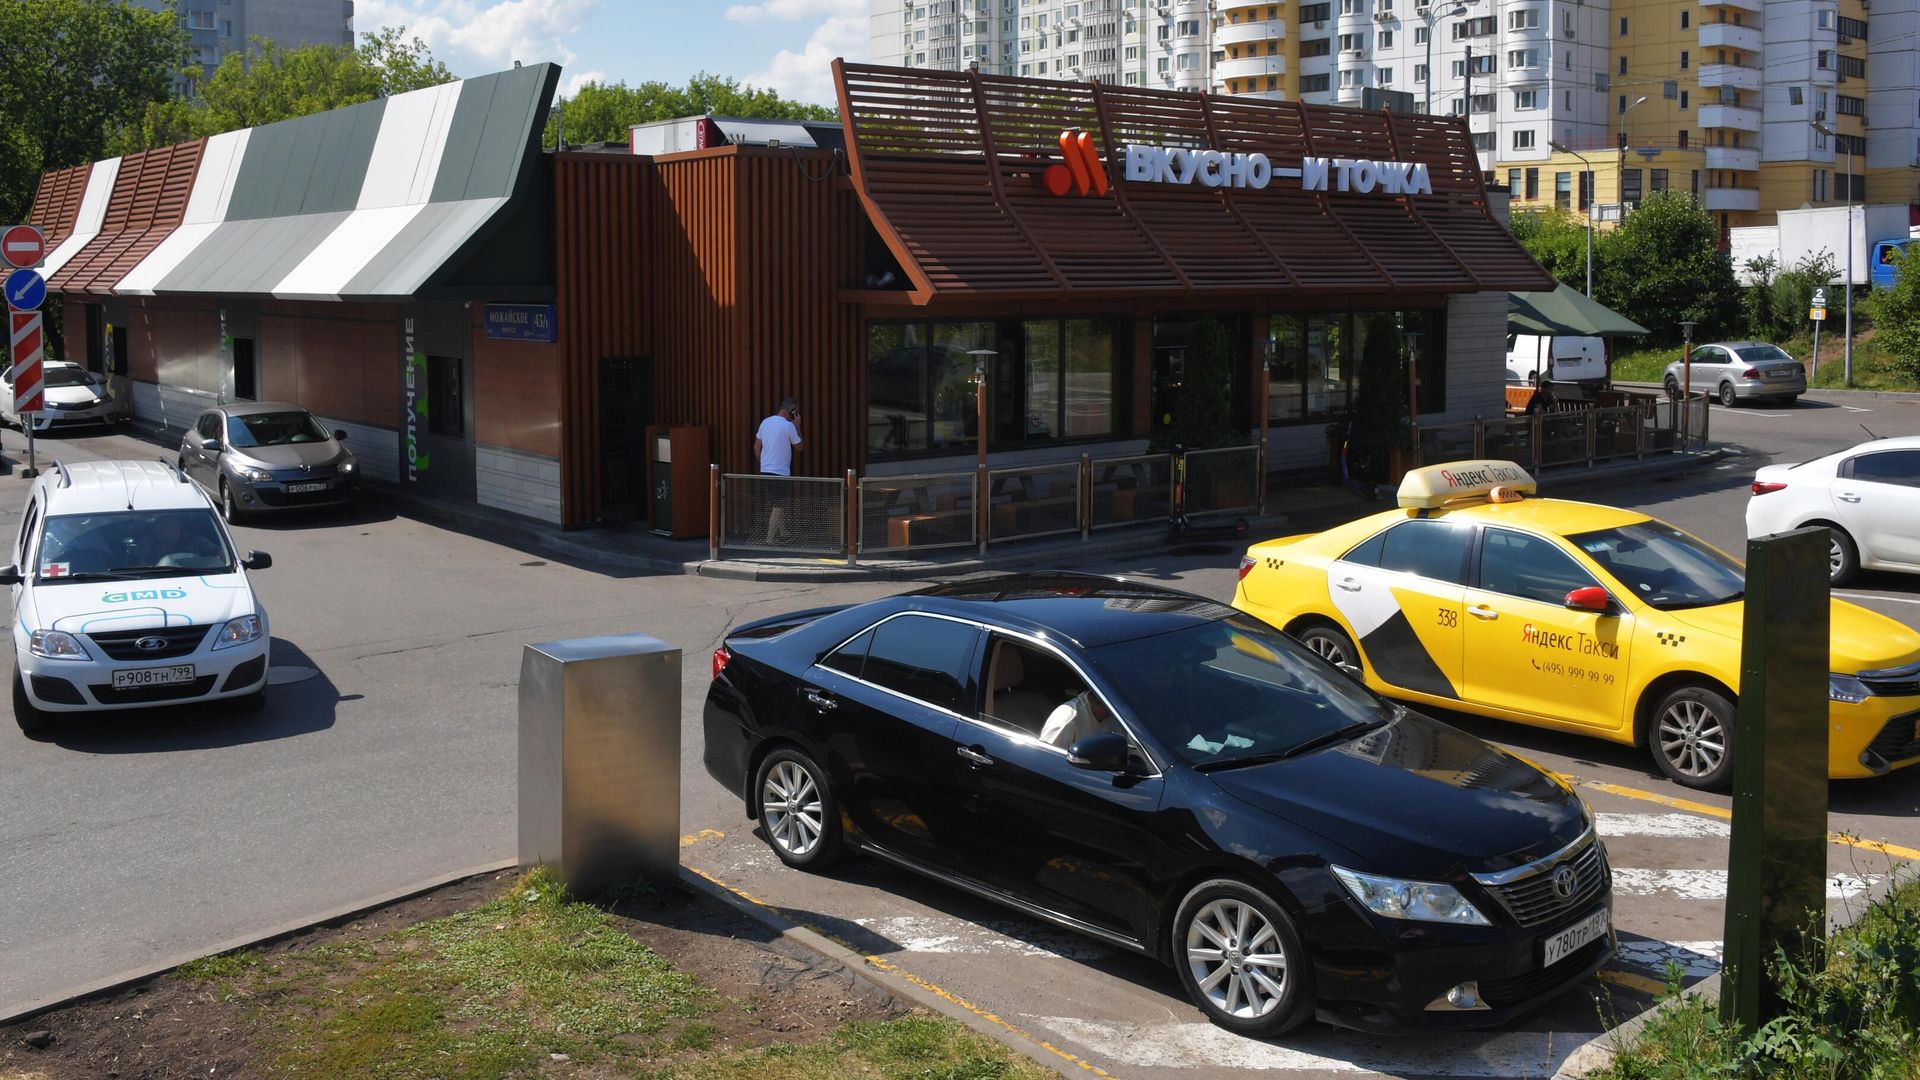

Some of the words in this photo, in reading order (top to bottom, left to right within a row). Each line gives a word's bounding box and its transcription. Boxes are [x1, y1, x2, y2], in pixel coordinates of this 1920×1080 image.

[1331, 158, 1433, 195] ТОЧКА
[1815, 288, 1824, 298] 2
[489, 309, 529, 325] МОЖАЙСКОЕ
[404, 317, 418, 482] ПОЛУЧЕНИЕ
[1441, 469, 1493, 490] Яндекс
[1483, 464, 1523, 484] Такси
[102, 589, 187, 603] CMD
[1436, 608, 1458, 628] 338
[1521, 623, 1574, 652] Яндекс
[1576, 632, 1620, 660] Такси
[170, 667, 190, 677] 799
[1541, 660, 1564, 677] (495)
[1567, 666, 1585, 681] 999
[1586, 671, 1600, 683] 99
[1602, 674, 1615, 686] 99
